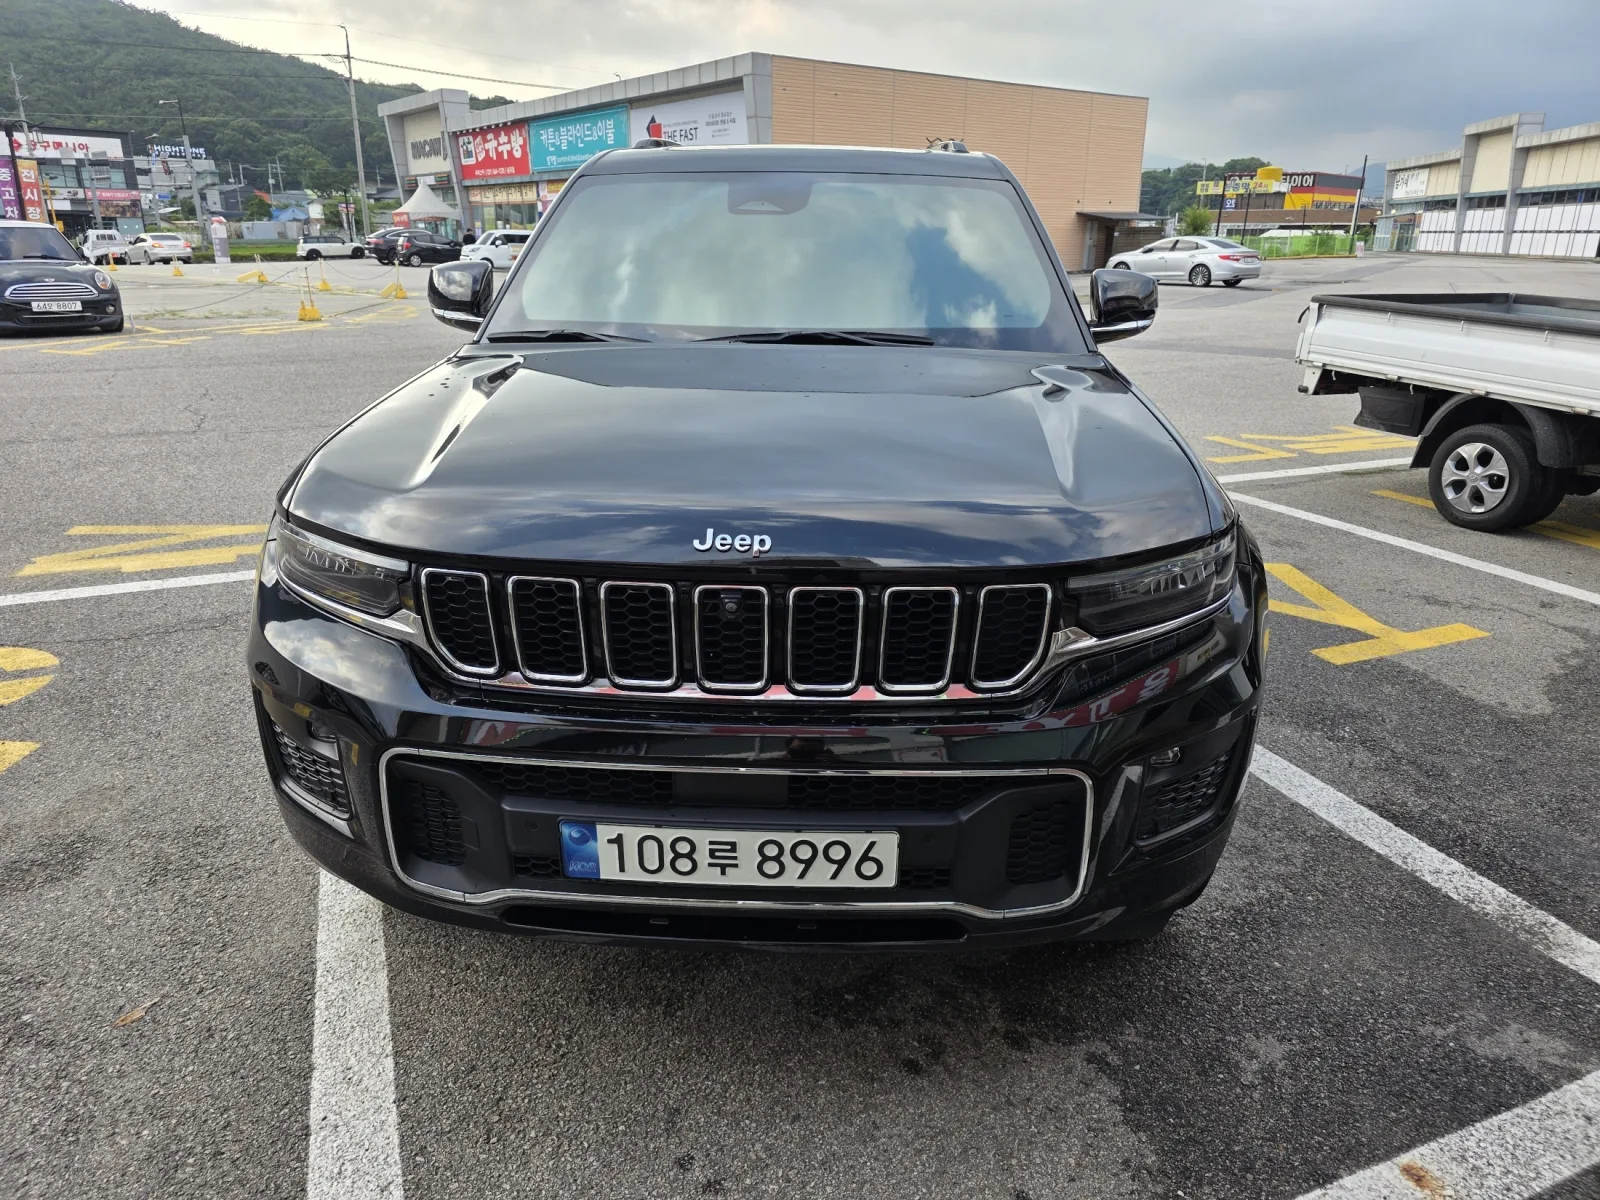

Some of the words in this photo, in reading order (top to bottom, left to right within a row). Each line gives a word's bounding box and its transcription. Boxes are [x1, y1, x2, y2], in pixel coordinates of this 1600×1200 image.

[154, 144, 206, 154] HIGHTNE
[540, 118, 615, 151] 커튼&블라인드&이불
[663, 130, 677, 142] THE
[679, 127, 698, 142] FAST
[0, 168, 18, 219] 중고차
[21, 169, 41, 220] 전시장
[57, 302, 77, 310] 8807
[693, 528, 772, 558] Jeep
[568, 860, 597, 873] KOR
[606, 832, 739, 877] 108루
[756, 838, 885, 882] 8996
